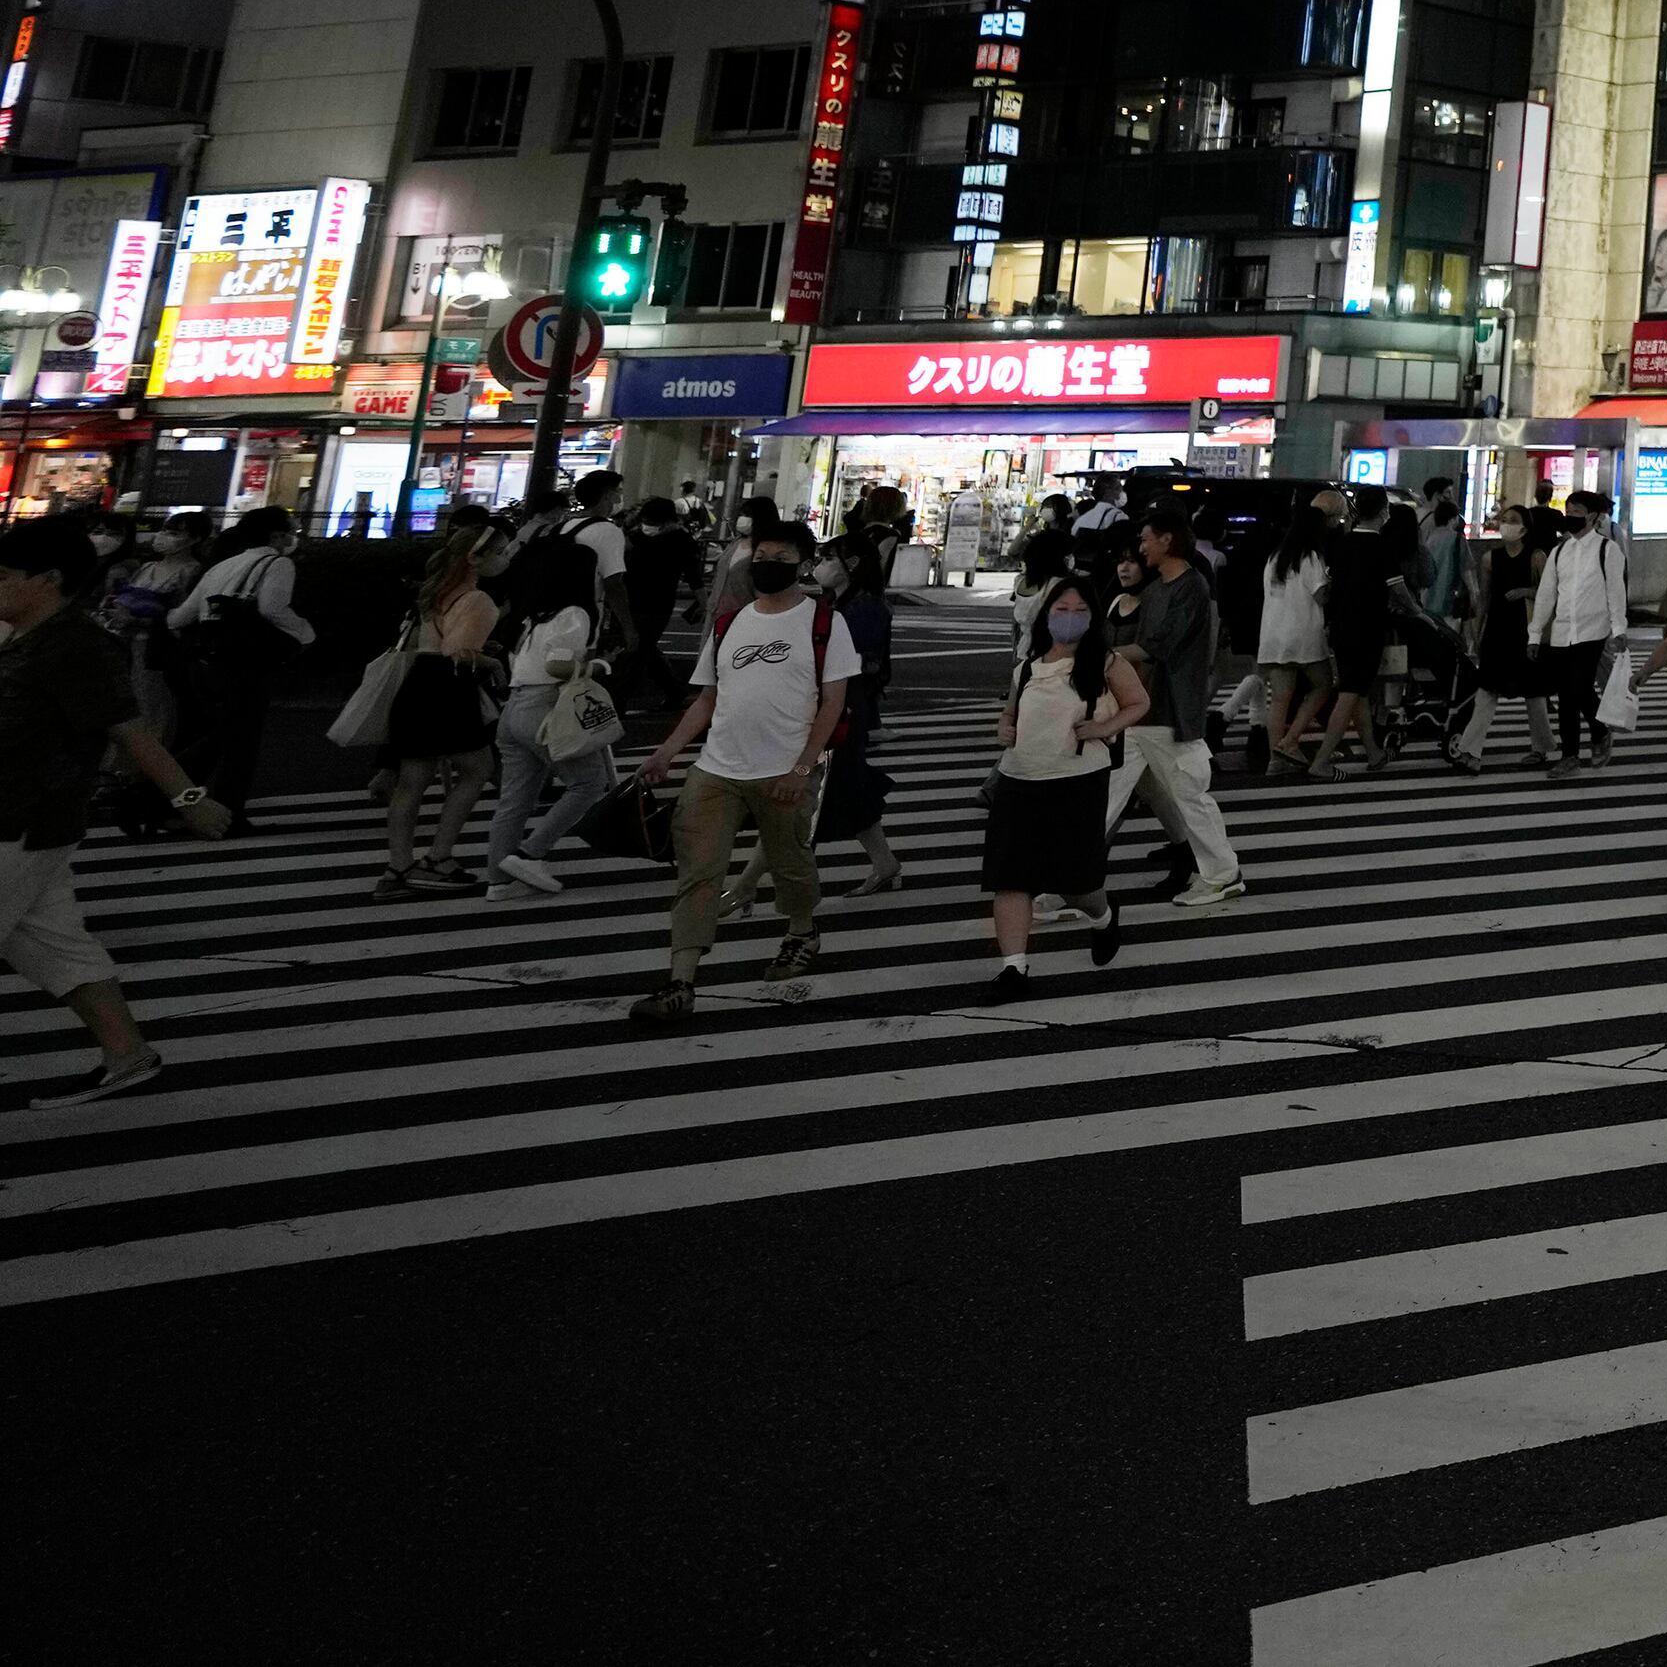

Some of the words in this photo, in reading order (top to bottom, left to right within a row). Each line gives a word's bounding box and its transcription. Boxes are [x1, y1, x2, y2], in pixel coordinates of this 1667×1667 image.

[803, 28, 853, 224] クスリの龍生堂
[220, 211, 295, 248] 三平
[325, 186, 348, 244] GAME
[103, 234, 147, 352] 三平ストア
[790, 289, 823, 301] BEAUTY
[792, 270, 824, 283] HEALTH
[662, 377, 736, 398] atmos
[908, 344, 1150, 397] クスリの龍生堂
[354, 397, 408, 416] GAME
